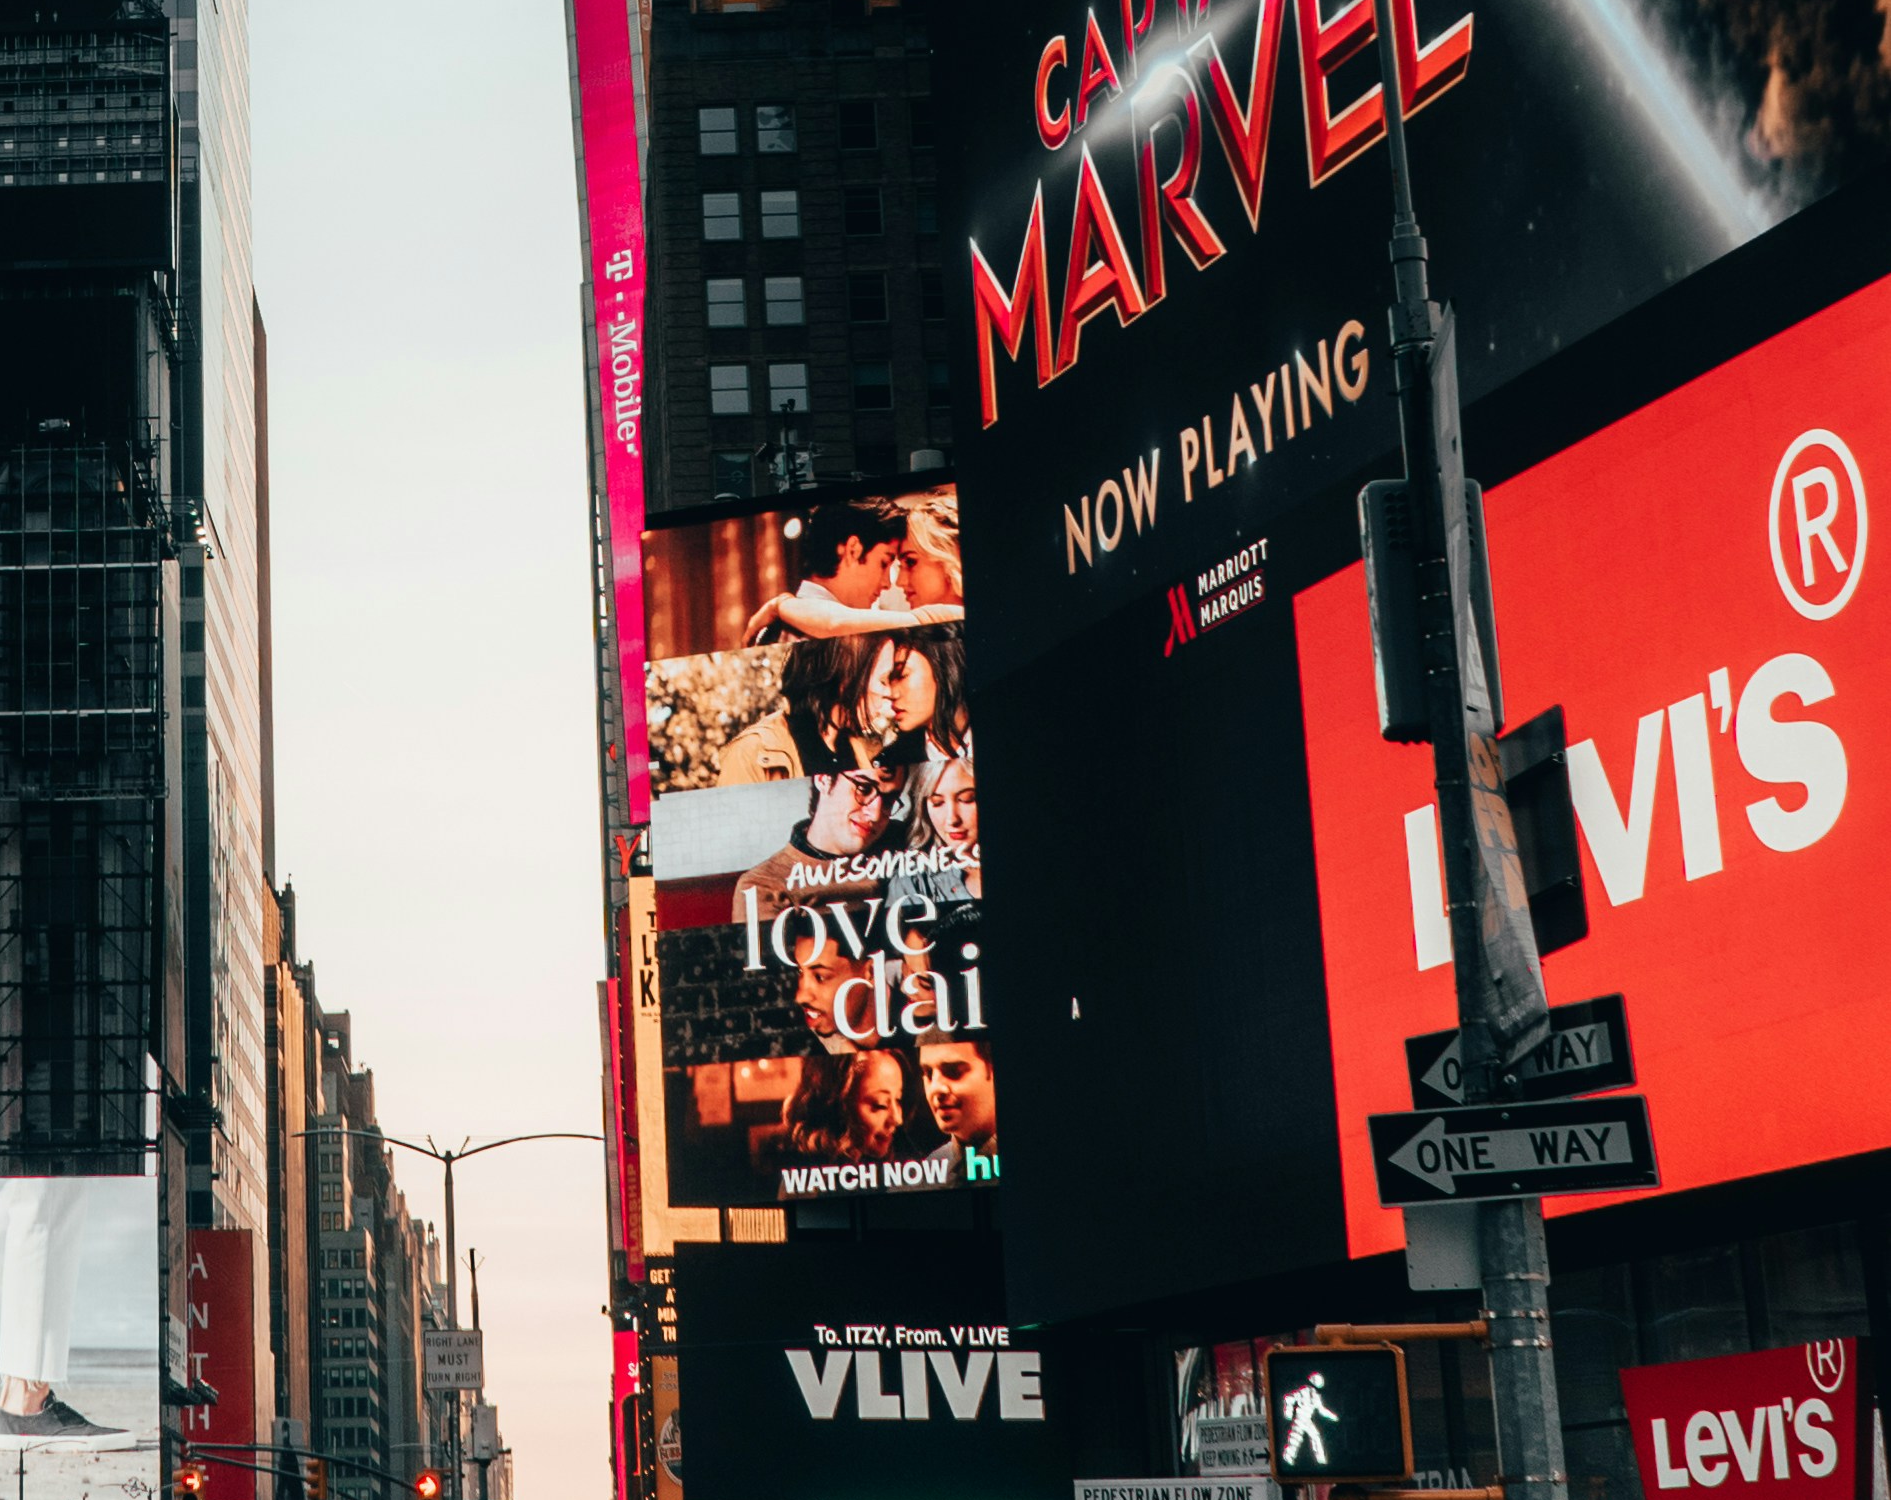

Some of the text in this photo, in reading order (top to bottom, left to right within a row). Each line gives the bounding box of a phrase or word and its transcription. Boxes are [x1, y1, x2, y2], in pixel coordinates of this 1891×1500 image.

[1064, 319, 1369, 575] NOW PLAYING
[1198, 538, 1268, 596] MARRIOTT
[1200, 575, 1263, 627] MARQUIS
[741, 885, 938, 972] love
[833, 942, 988, 1041] dai
[1417, 1127, 1611, 1174] ONE WAY
[782, 1163, 878, 1194] WATCH
[883, 1158, 948, 1188] NOW
[425, 1337, 480, 1348] RIGHT LANE
[437, 1354, 469, 1366] MUST
[846, 1324, 891, 1348] ITZY,
[950, 1325, 965, 1346] V
[968, 1326, 1010, 1346] LIVE
[427, 1371, 481, 1382] TURN RIGHT
[784, 1348, 1046, 1421] VLIVE
